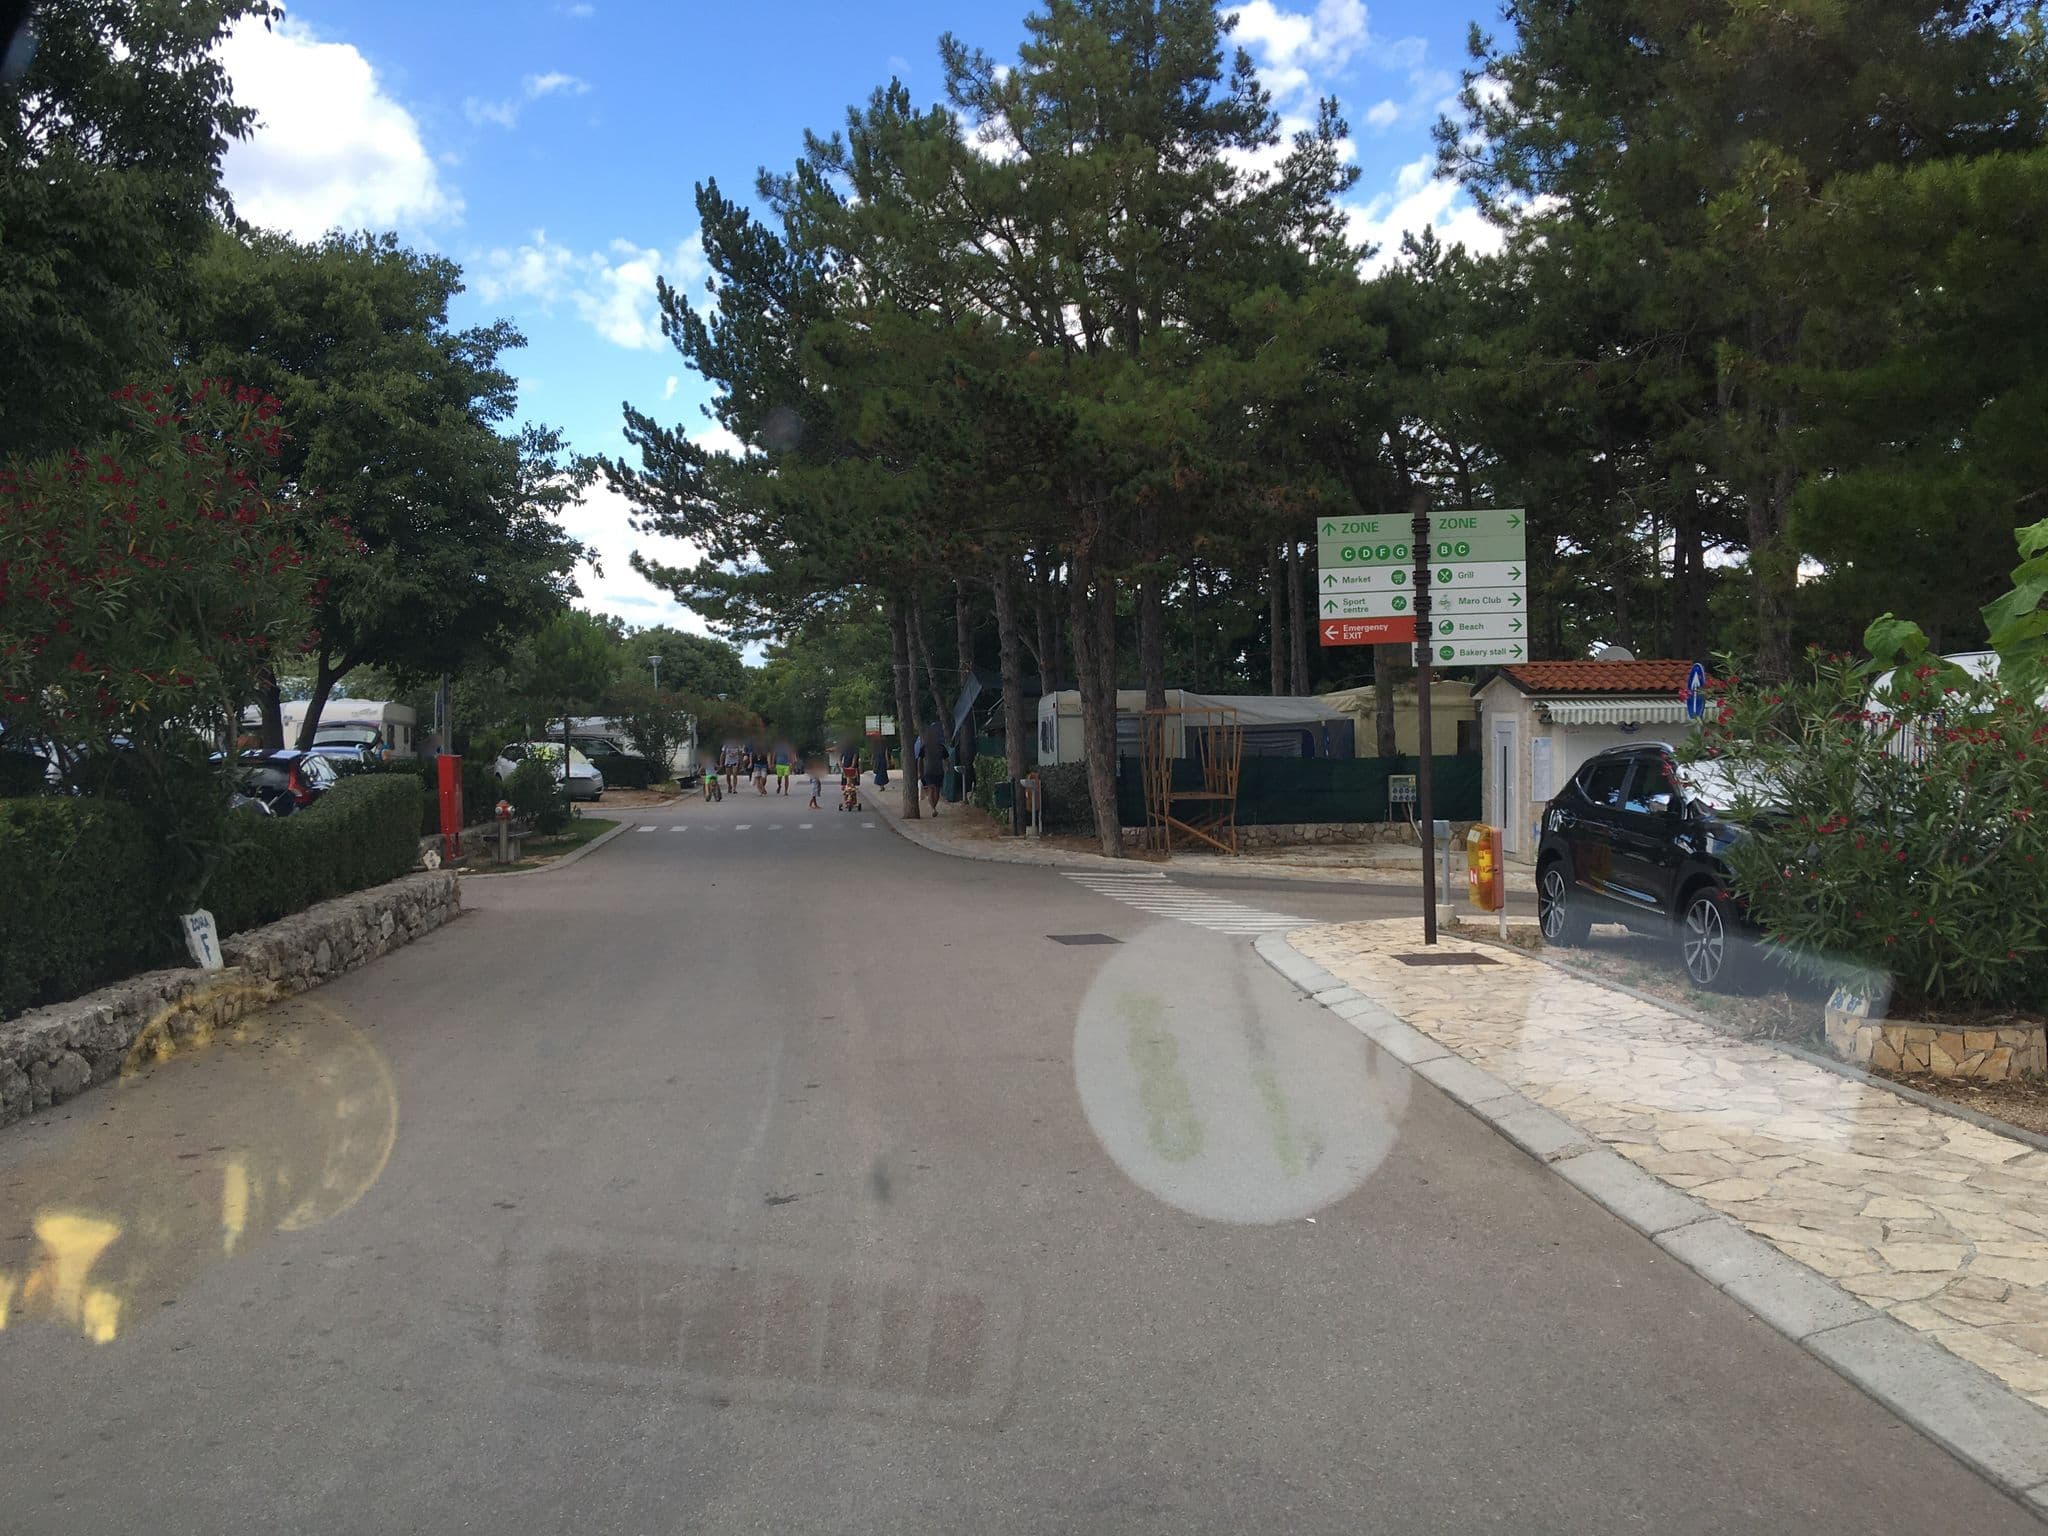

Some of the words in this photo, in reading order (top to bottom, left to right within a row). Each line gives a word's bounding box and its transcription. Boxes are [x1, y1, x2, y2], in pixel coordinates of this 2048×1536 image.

[1341, 521, 1380, 534] ZONE
[1438, 517, 1478, 530] ZONE
[1344, 549, 1352, 559] C
[1362, 549, 1371, 558] D
[1379, 548, 1387, 557] F
[1396, 547, 1405, 556] G
[1440, 545, 1449, 554] B
[1458, 545, 1467, 554] C
[1458, 571, 1474, 579] Grill
[1342, 576, 1371, 584] Market
[1343, 598, 1366, 607] Sport
[1458, 597, 1480, 605] Maro
[1482, 596, 1502, 604] Club
[1343, 624, 1389, 633] Emergency
[1459, 623, 1484, 631] Beach
[1343, 632, 1363, 640] EXIT
[1459, 648, 1488, 657] Bakery
[1489, 648, 1507, 656] stall
